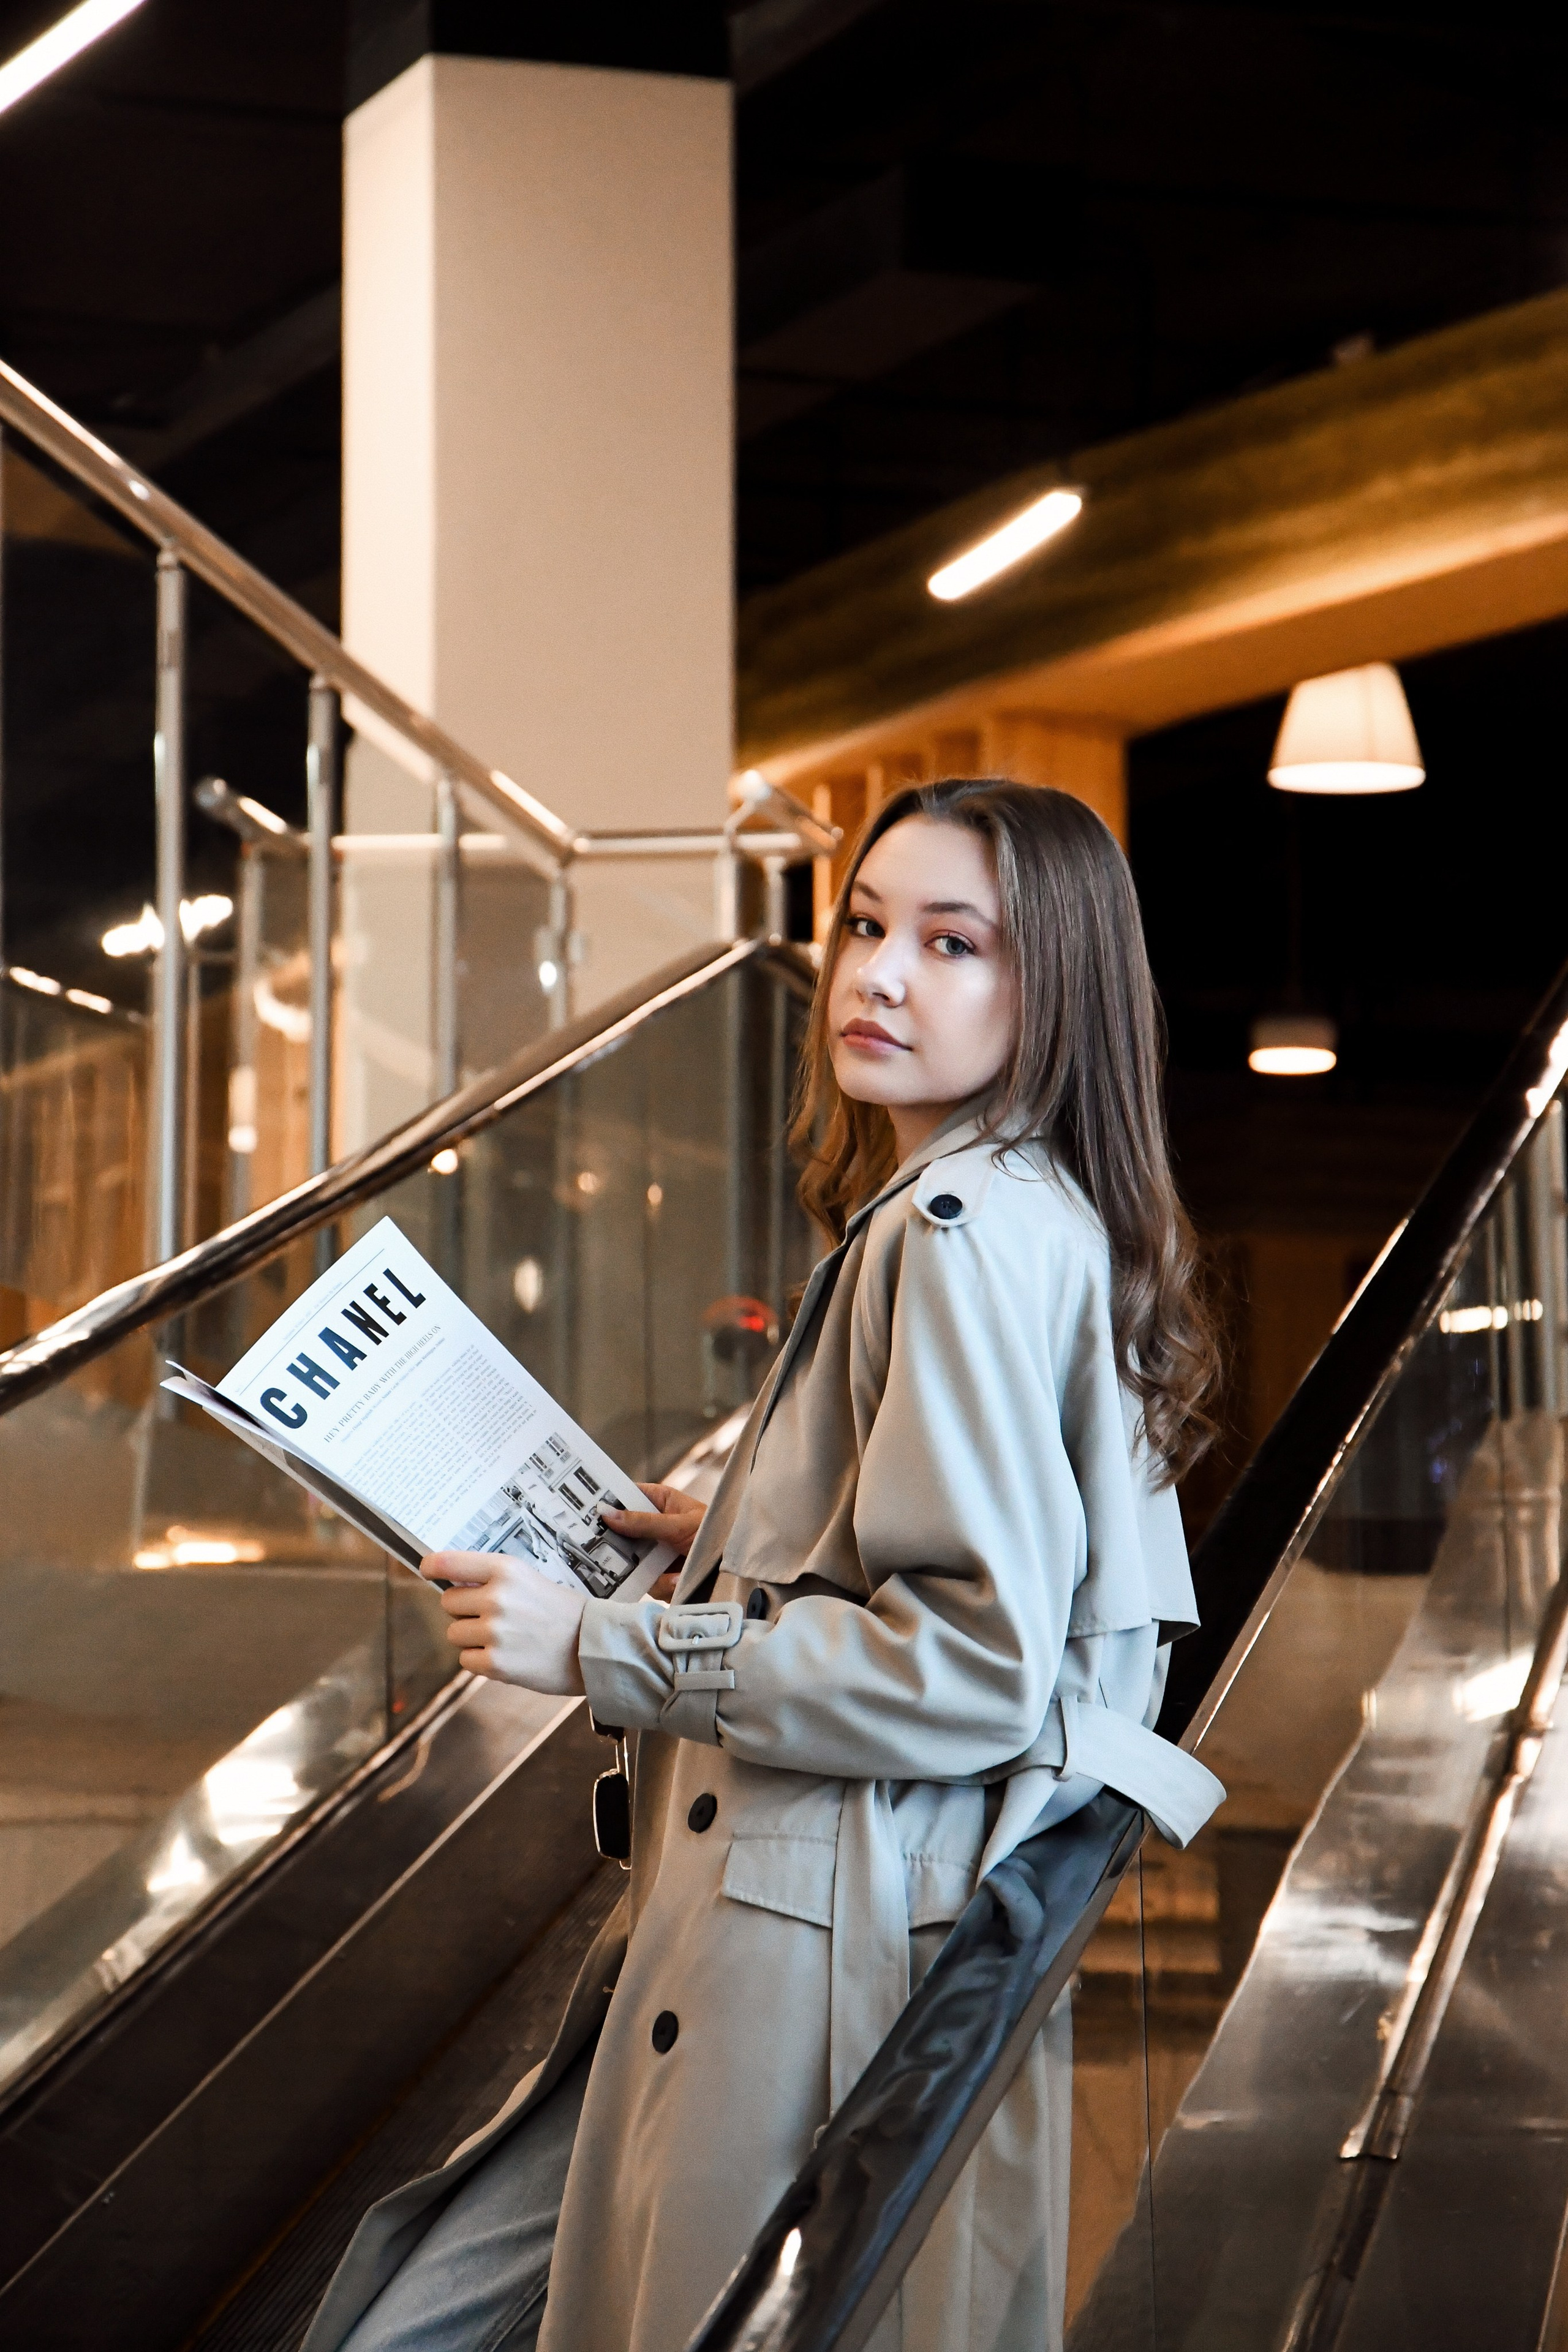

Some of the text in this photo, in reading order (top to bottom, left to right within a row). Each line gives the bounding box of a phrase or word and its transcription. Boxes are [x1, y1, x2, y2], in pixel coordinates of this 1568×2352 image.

[260, 1267, 426, 1428] CHANEL
[323, 1426, 339, 1442] HEY
[338, 1401, 364, 1427] PRETTY
[363, 1382, 380, 1400] BABY
[379, 1366, 397, 1383] WITH
[394, 1356, 407, 1368] THE
[404, 1344, 419, 1359] HIGH
[416, 1331, 433, 1348] HEELS
